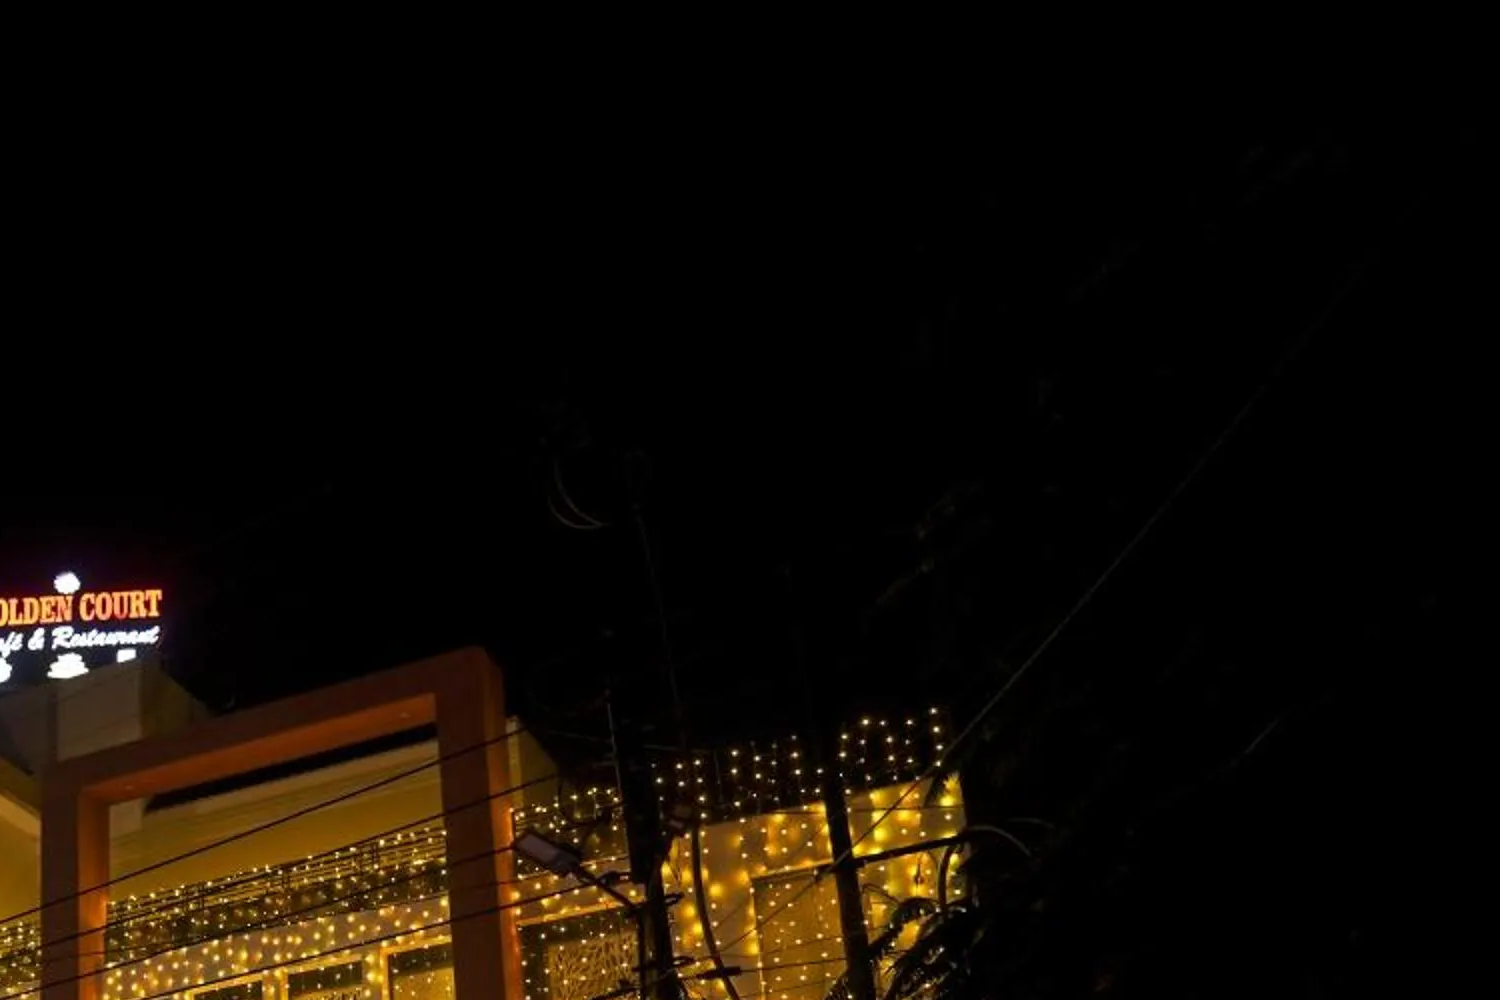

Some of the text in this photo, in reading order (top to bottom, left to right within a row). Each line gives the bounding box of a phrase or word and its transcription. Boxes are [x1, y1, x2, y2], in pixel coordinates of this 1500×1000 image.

[79, 588, 163, 622] COURT
[27, 627, 46, 650] &
[51, 625, 161, 650] Restaurant
